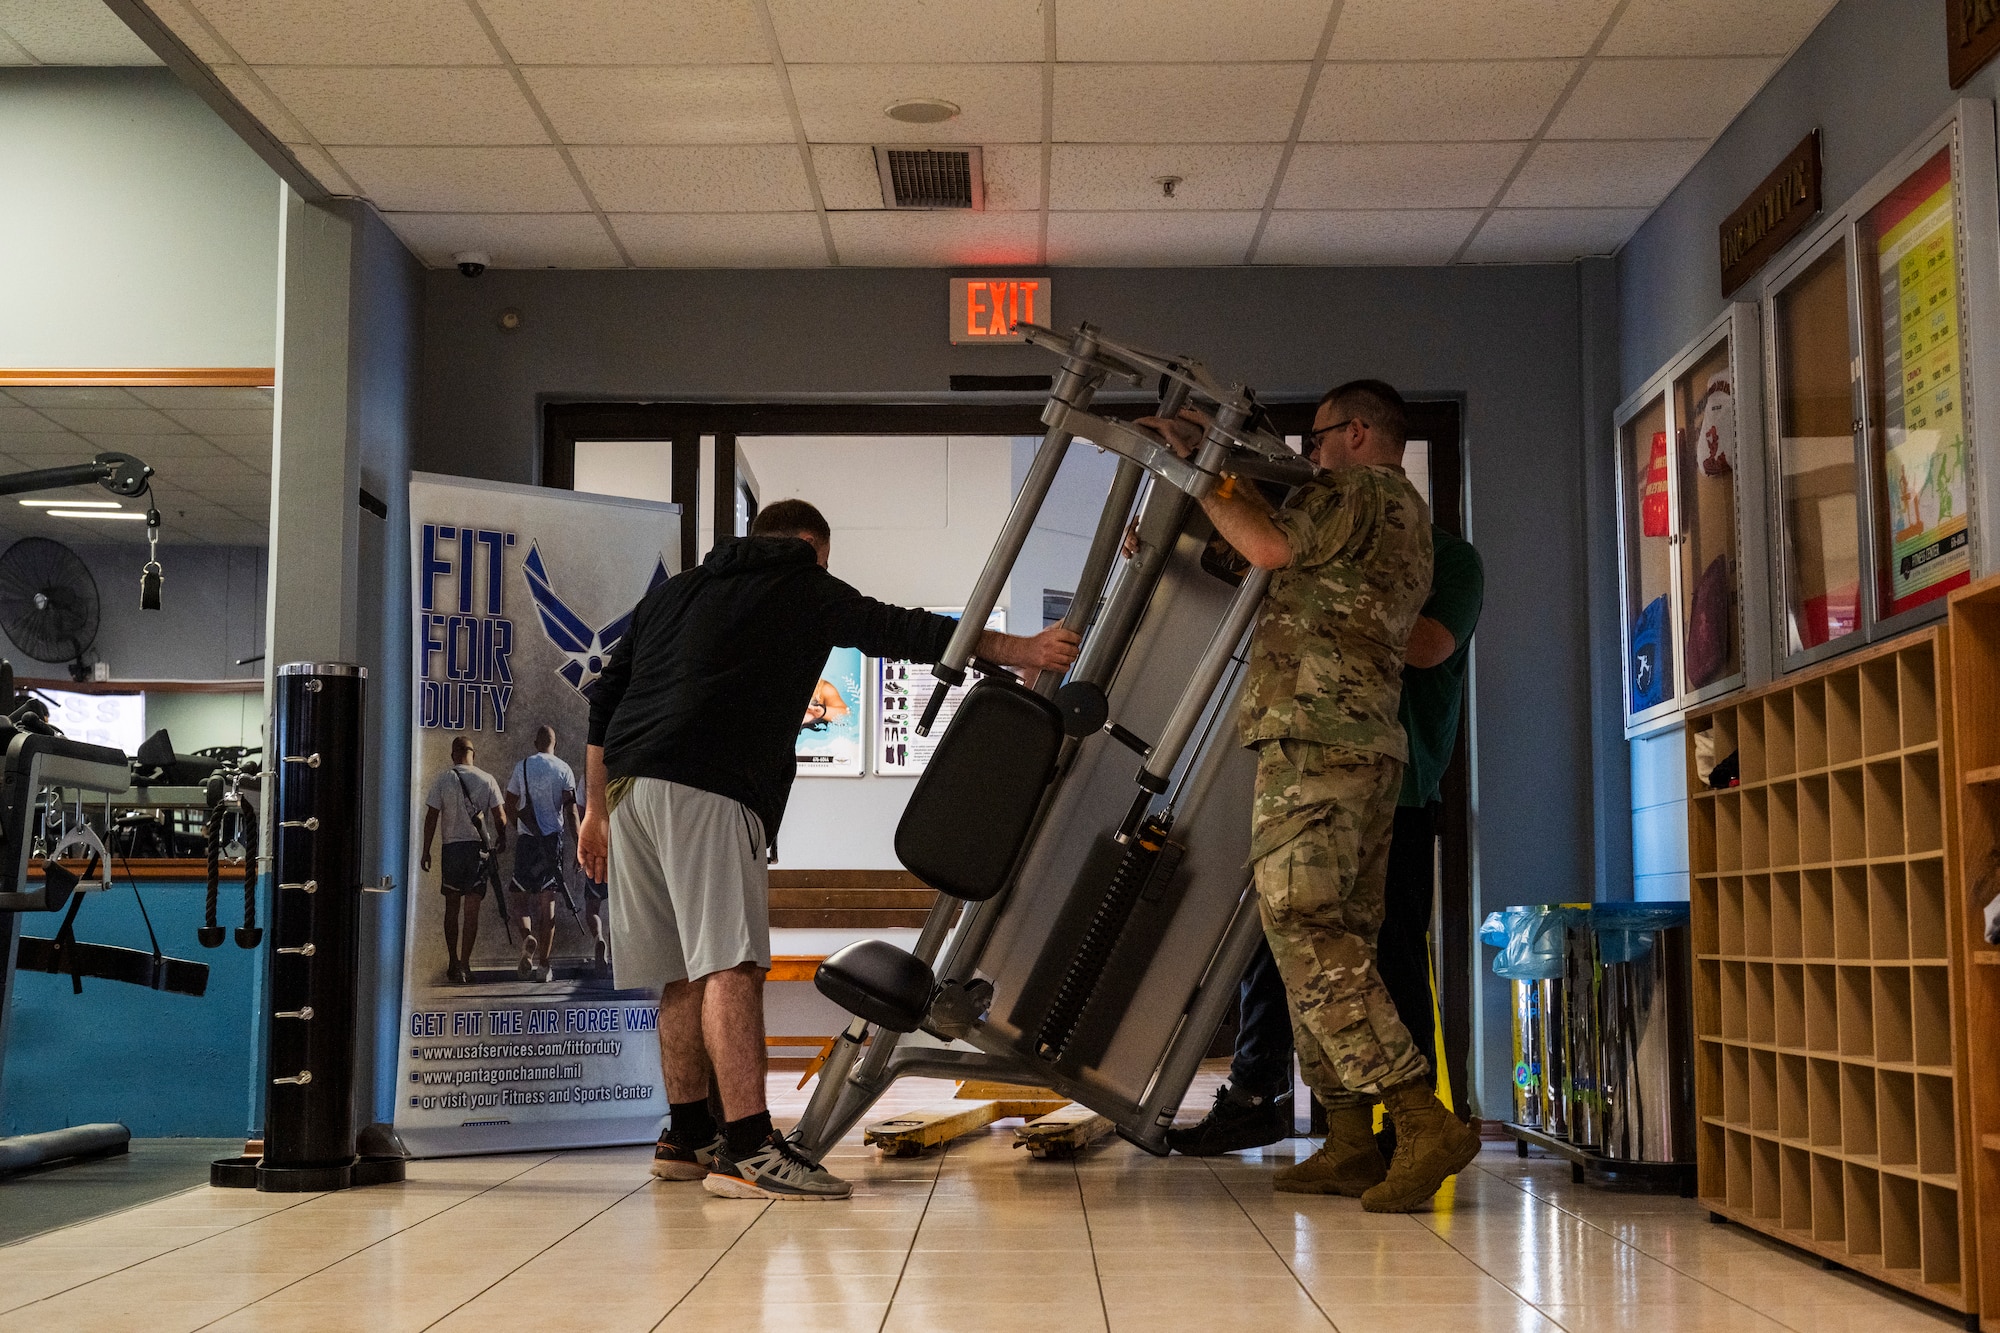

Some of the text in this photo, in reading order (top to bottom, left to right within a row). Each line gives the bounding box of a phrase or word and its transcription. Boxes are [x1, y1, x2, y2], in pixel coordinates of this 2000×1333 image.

[967, 282, 1039, 336] EXIT
[421, 523, 516, 616] FIT
[419, 613, 513, 684] FOR
[419, 680, 513, 732] DUTY
[411, 1007, 660, 1037] GET FIT THE AIR FORCE WAY
[424, 1040, 621, 1060] www.usafservices.com/fitforduty
[424, 1064, 582, 1086] www.pentagonchannel.mil
[422, 1084, 652, 1110] or visit your Fitness and Sports Center
